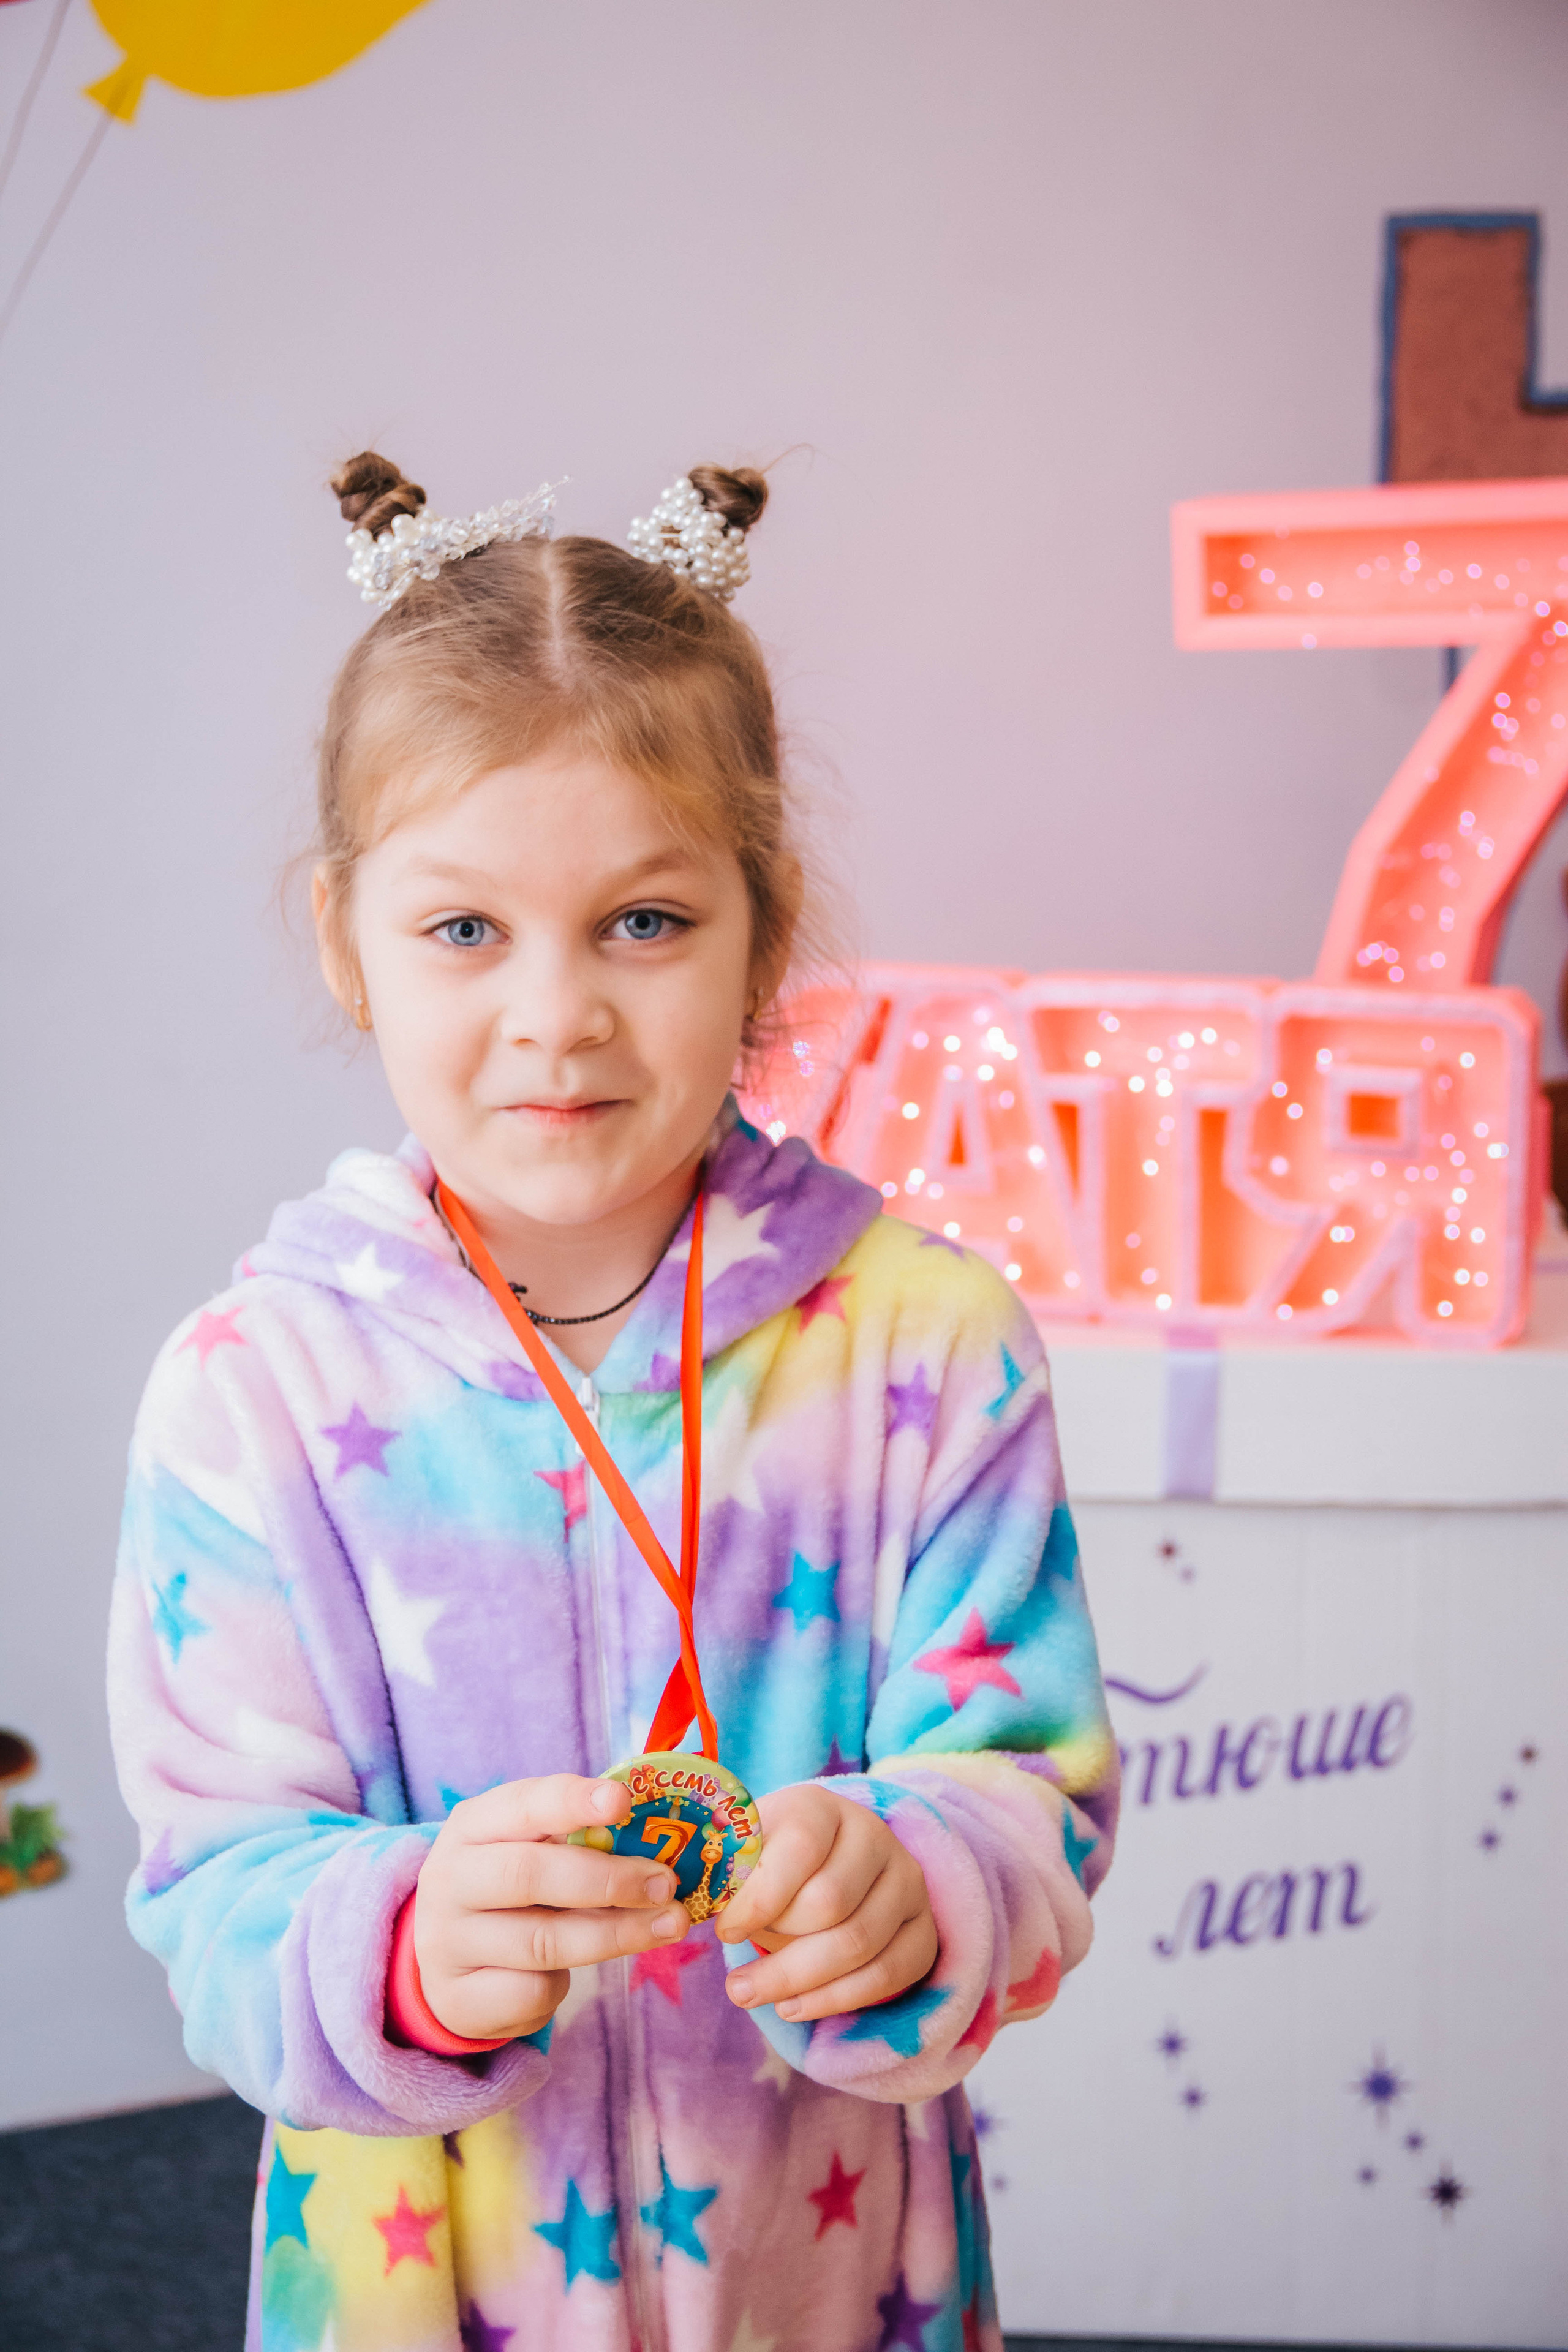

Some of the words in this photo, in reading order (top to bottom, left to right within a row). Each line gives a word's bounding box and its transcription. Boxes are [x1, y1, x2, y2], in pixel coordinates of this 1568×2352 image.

[1171, 478, 1568, 985] 7
[654, 1770, 717, 1798] семь
[718, 1795, 754, 1839] лет
[641, 1816, 698, 1885] 7
[1153, 1860, 1379, 1958] лет
